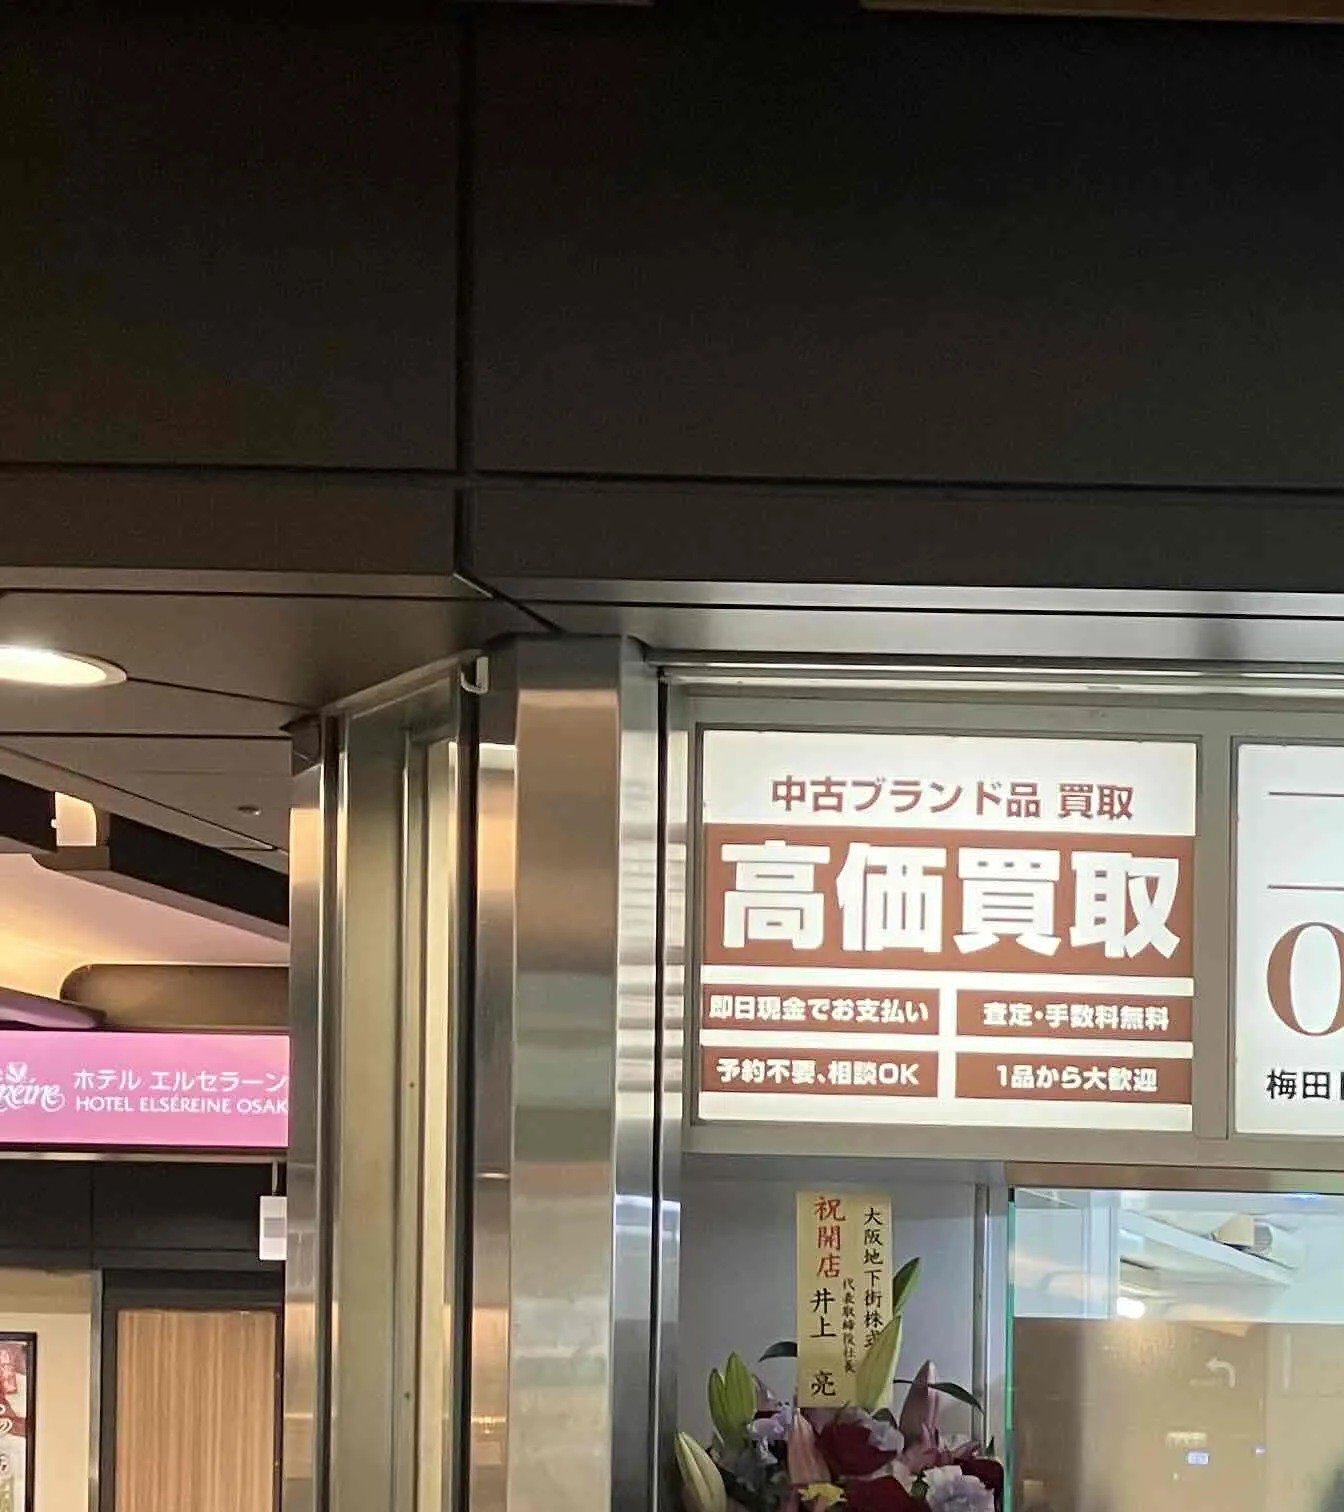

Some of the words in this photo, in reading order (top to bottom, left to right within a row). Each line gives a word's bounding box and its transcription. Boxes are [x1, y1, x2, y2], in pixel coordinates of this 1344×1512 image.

[771, 775, 1041, 818] 中古ブランド品
[1057, 782, 1135, 821] 買取
[720, 839, 1182, 960] 高価買取
[708, 994, 929, 1025] 即日現金でお支払い
[73, 1068, 142, 1092] ホテル
[996, 1063, 1159, 1092] 1品から大歓迎
[76, 1095, 134, 1113] HOTEL
[814, 1195, 846, 1280] 祝開店
[810, 1287, 838, 1338] 井上
